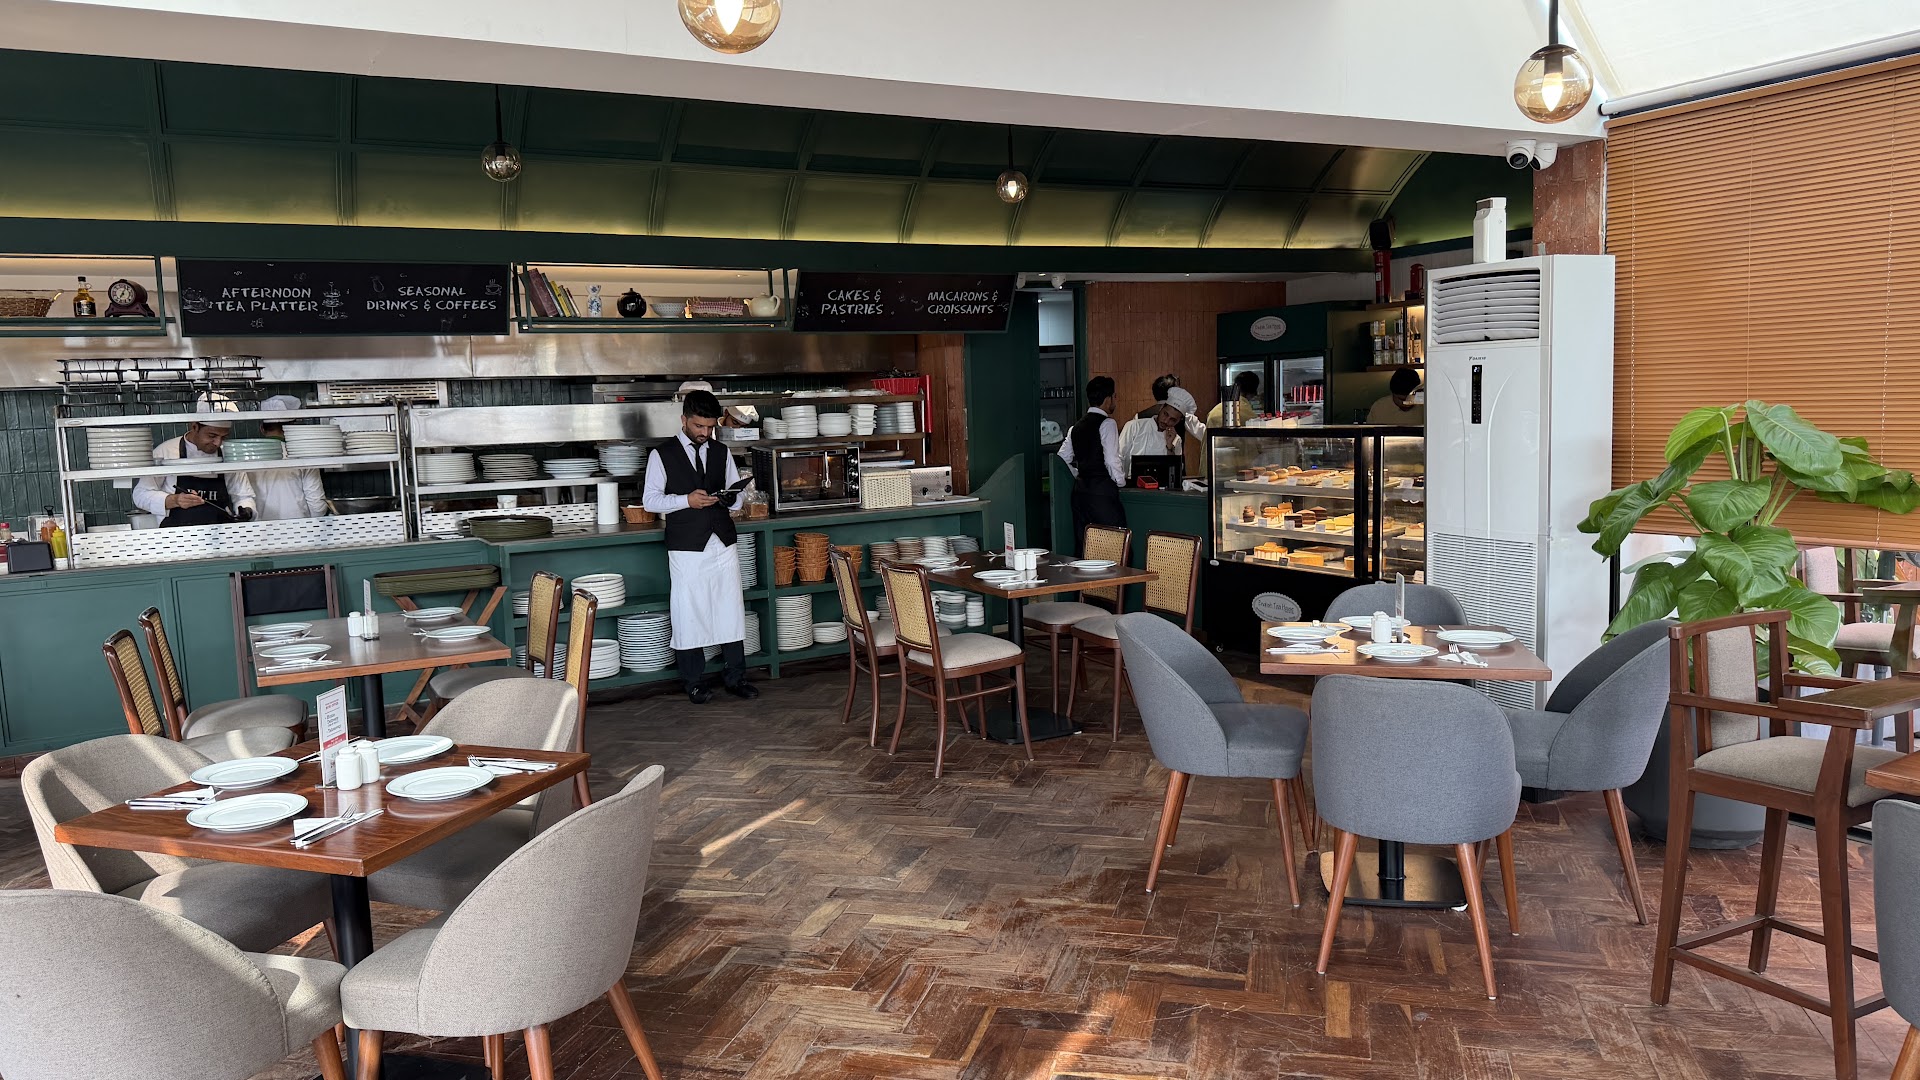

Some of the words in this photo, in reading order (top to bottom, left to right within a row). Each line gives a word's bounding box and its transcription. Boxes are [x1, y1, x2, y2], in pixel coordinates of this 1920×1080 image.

[221, 287, 312, 298] AFTERNOON
[397, 286, 467, 297] SEASONAL
[827, 289, 871, 301] CAKES
[874, 289, 882, 303] &
[927, 291, 989, 302] MACARONS
[991, 290, 999, 303] &
[215, 301, 246, 312] TEA
[250, 301, 319, 312] PLATTER
[366, 300, 419, 311] DRINKS
[423, 299, 432, 312] &
[435, 300, 497, 310] COFFEES
[820, 303, 884, 315] PASTRIES
[927, 304, 995, 315] CROISSANTS
